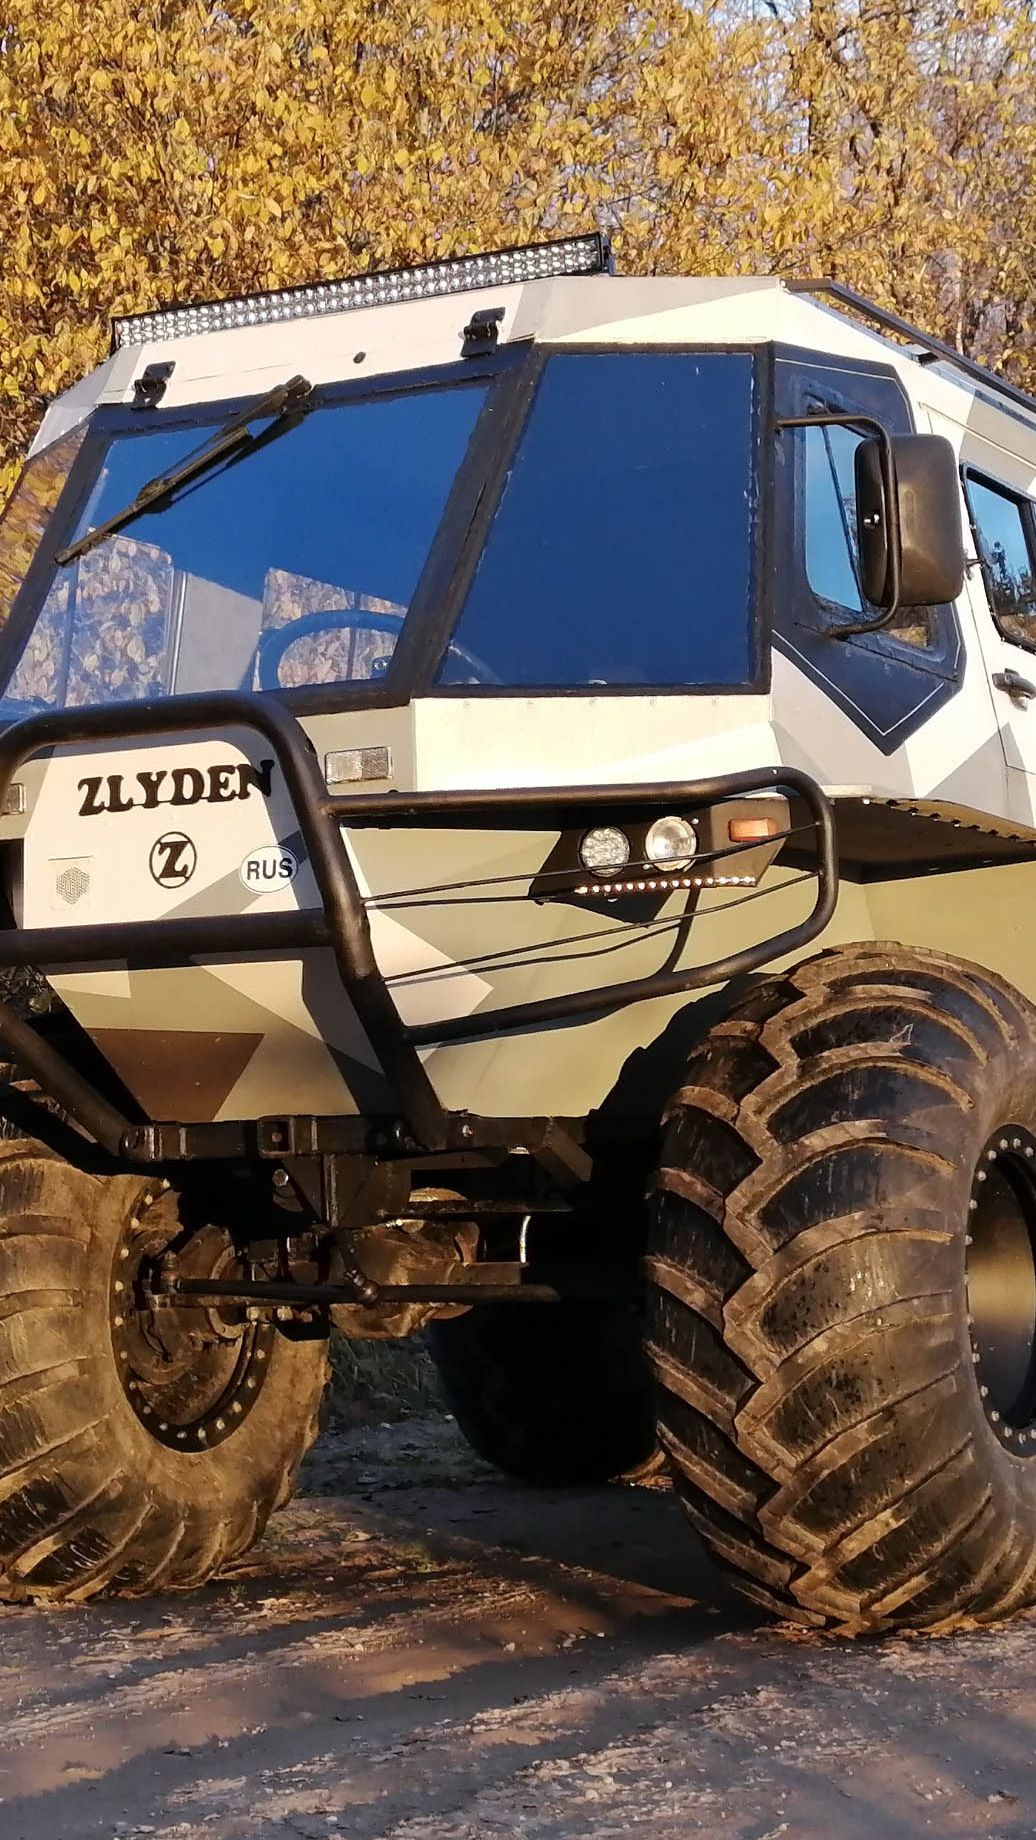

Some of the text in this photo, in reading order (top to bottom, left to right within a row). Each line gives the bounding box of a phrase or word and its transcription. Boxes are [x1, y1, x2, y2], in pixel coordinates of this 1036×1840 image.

[77, 759, 274, 816] ZLYDEN
[157, 839, 191, 881] Z
[246, 857, 293, 881] RUS
